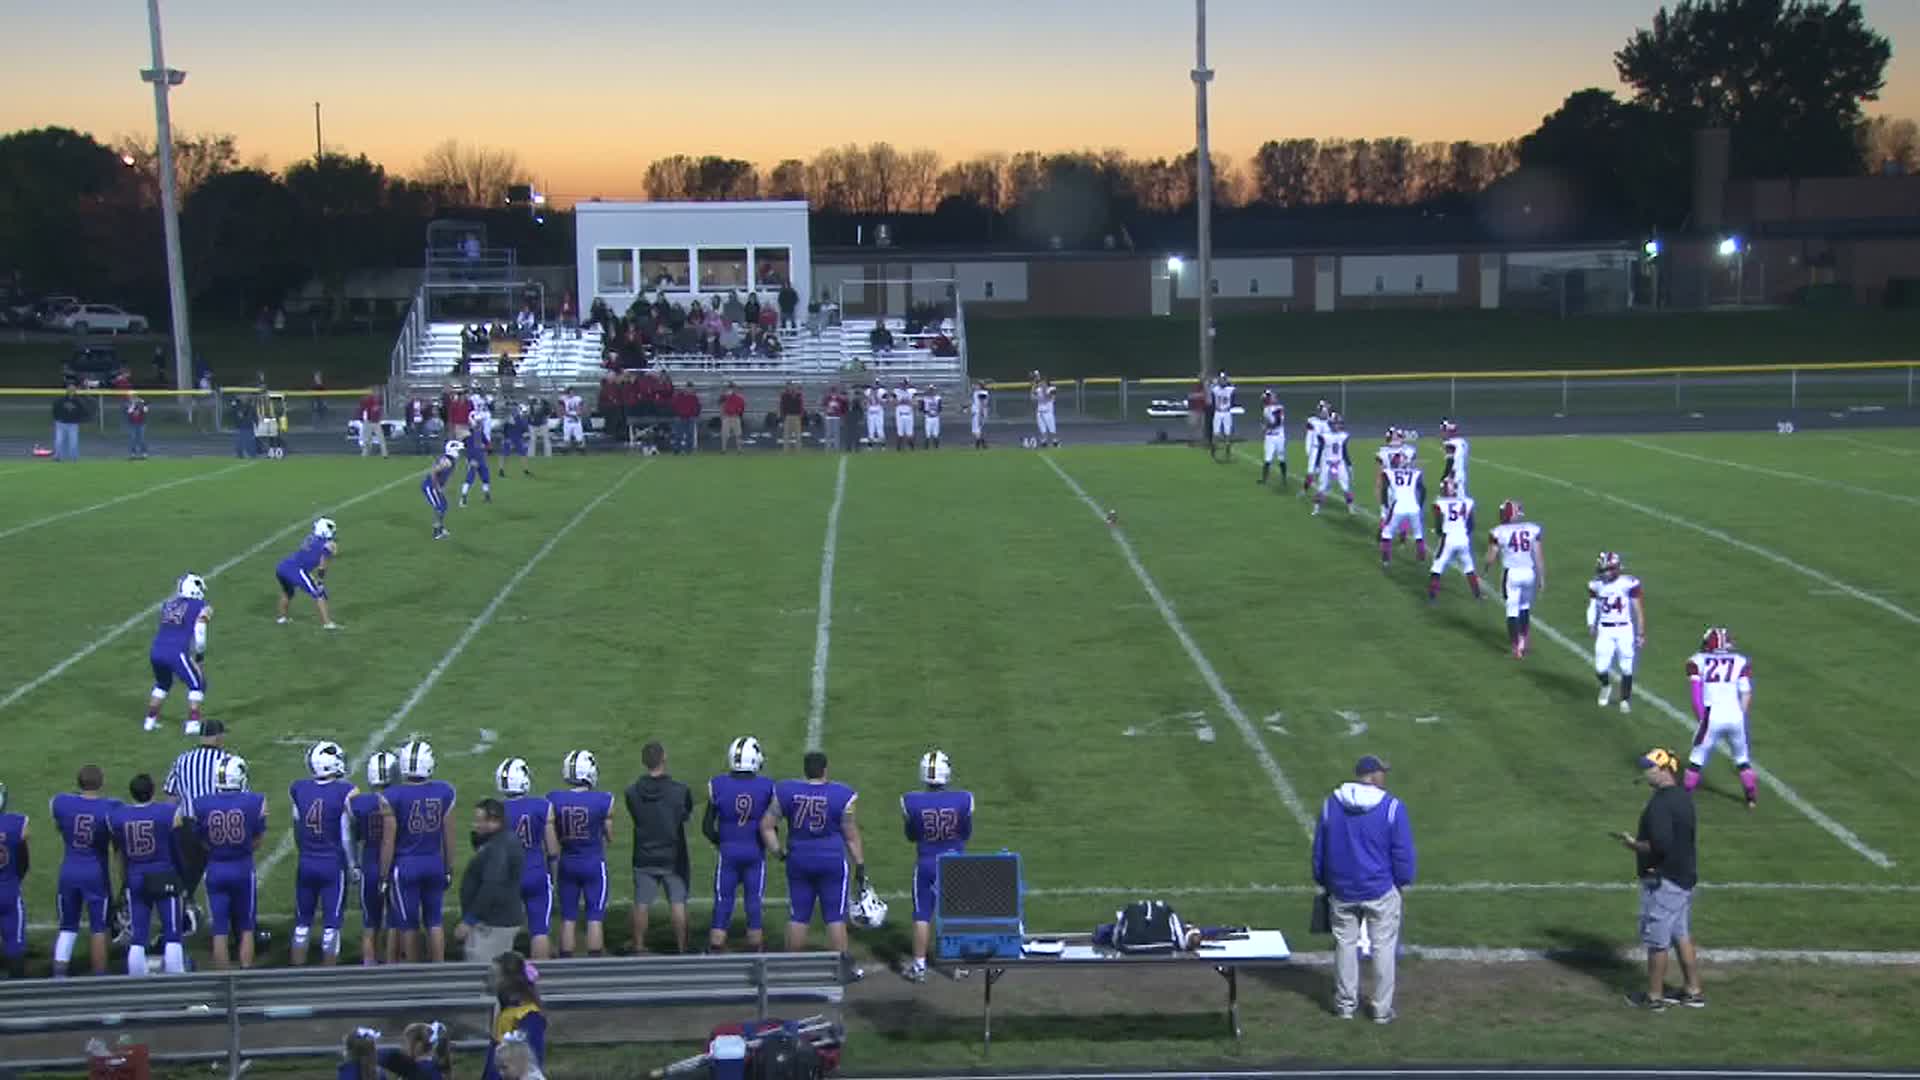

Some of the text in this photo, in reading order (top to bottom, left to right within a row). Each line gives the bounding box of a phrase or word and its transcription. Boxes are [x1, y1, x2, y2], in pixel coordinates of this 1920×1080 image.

[1394, 469, 1413, 487] 67
[1448, 502, 1467, 521] 54
[1508, 531, 1531, 552] 46
[1705, 657, 1735, 683] 27
[207, 808, 246, 846] 88
[304, 798, 323, 835] 4
[408, 797, 442, 835] 63
[561, 806, 590, 840] 12
[735, 794, 753, 828] 9
[792, 794, 828, 833] 75
[921, 808, 959, 841] 32
[72, 813, 96, 849] 5
[125, 819, 156, 857] 15
